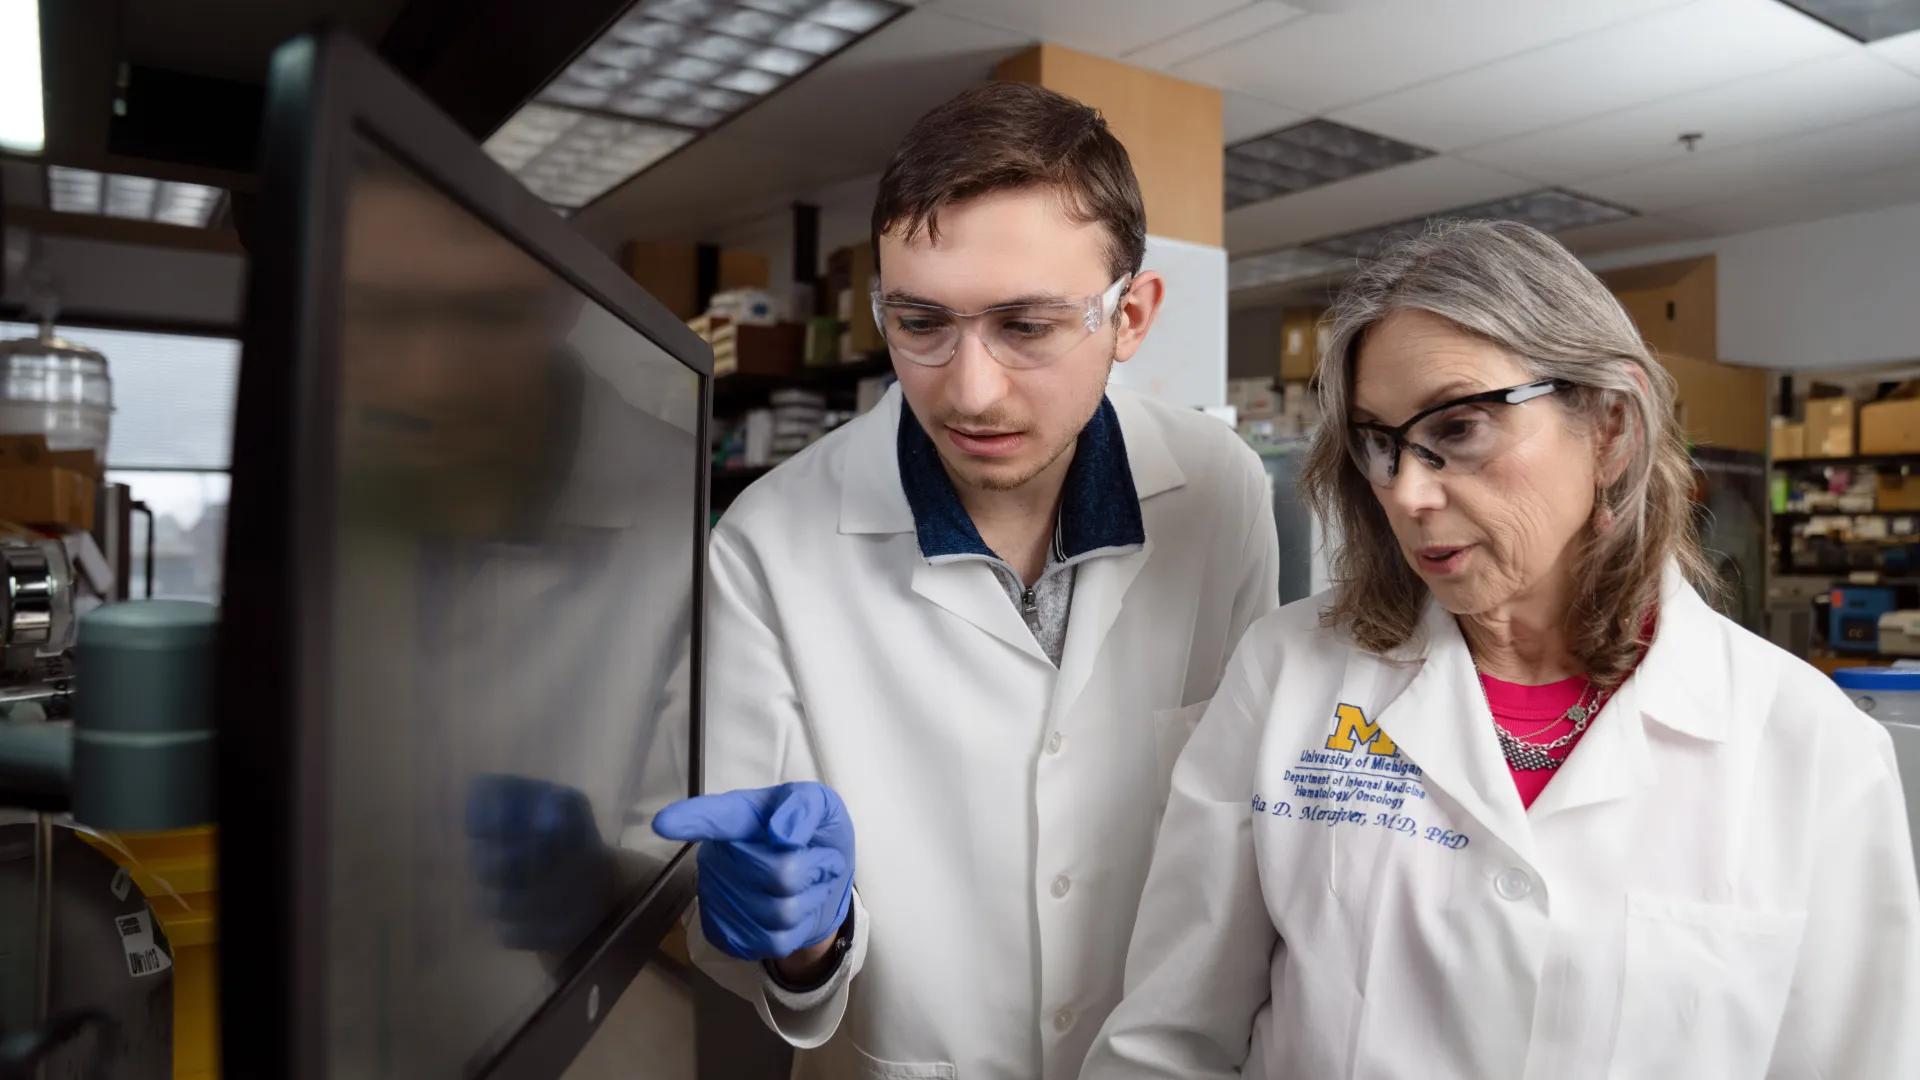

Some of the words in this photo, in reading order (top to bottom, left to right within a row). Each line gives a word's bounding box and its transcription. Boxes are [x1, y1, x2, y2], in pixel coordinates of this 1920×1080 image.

[1325, 702, 1400, 758] M
[1300, 749, 1352, 769] University
[1355, 757, 1369, 768] of
[1370, 756, 1422, 777] Michigan
[1283, 770, 1330, 785] Department
[1332, 775, 1342, 786] of
[1345, 777, 1382, 790] Internal
[1385, 781, 1426, 800] Medicine
[1294, 786, 1405, 809] Hematology/Oncology
[1272, 801, 1292, 818] D.
[1299, 805, 1367, 827] Merajver,
[1373, 814, 1417, 837] MD,
[1424, 827, 1471, 850] PhD
